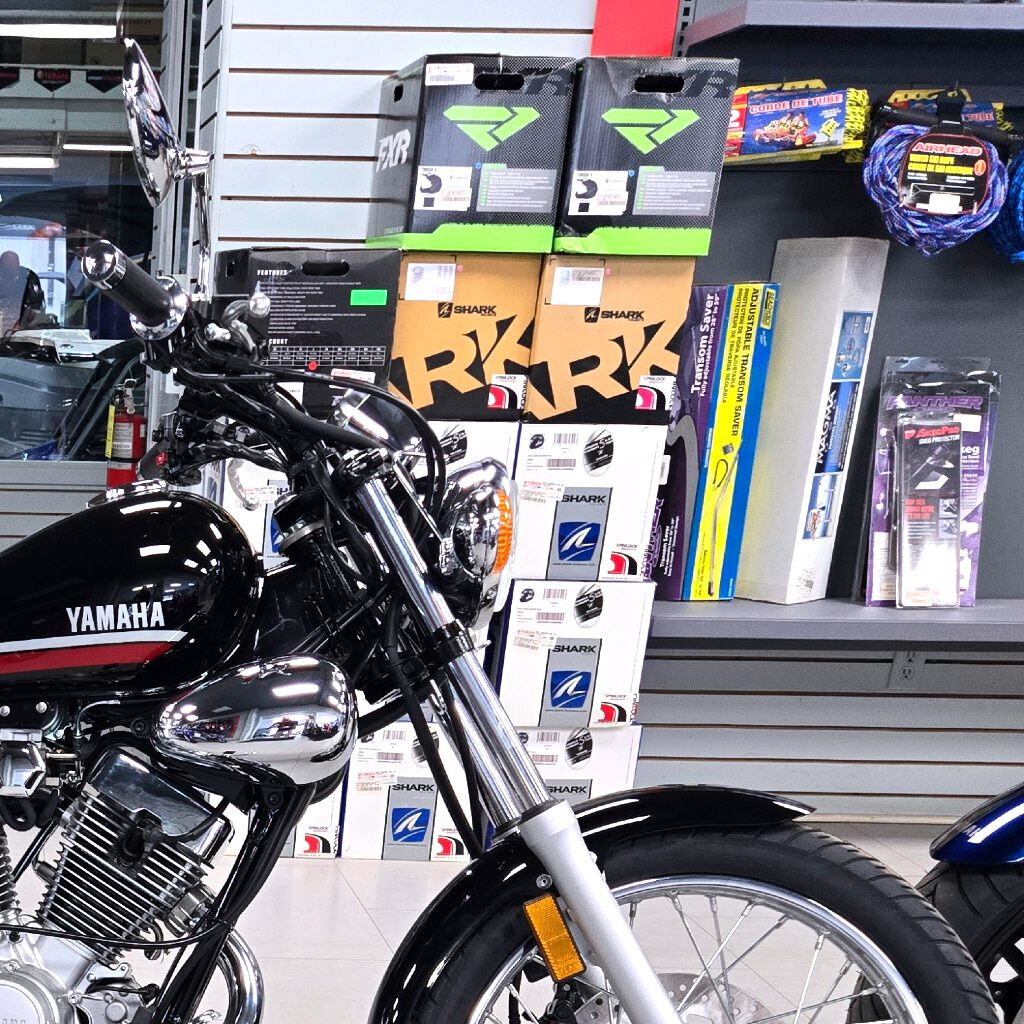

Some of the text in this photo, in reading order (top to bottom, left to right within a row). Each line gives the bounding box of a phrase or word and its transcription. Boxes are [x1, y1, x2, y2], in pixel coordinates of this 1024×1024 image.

[749, 101, 790, 114] CORDE
[811, 94, 843, 107] TUBE
[912, 142, 983, 156] AIRHEAD
[454, 305, 497, 314] SHARK
[601, 311, 645, 320] SHARK
[691, 294, 715, 393] Transom Saver
[703, 345, 713, 380] adjustable
[731, 288, 759, 437] ADJUSTABLE TRANSOM SAVER
[700, 381, 708, 397] Fully
[817, 390, 836, 463] MAGMA
[562, 495, 607, 503] SHARK
[660, 542, 668, 568] Transom
[66, 602, 165, 632] YAMAHA
[552, 645, 596, 653] SHARK
[392, 783, 435, 792] SHARK
